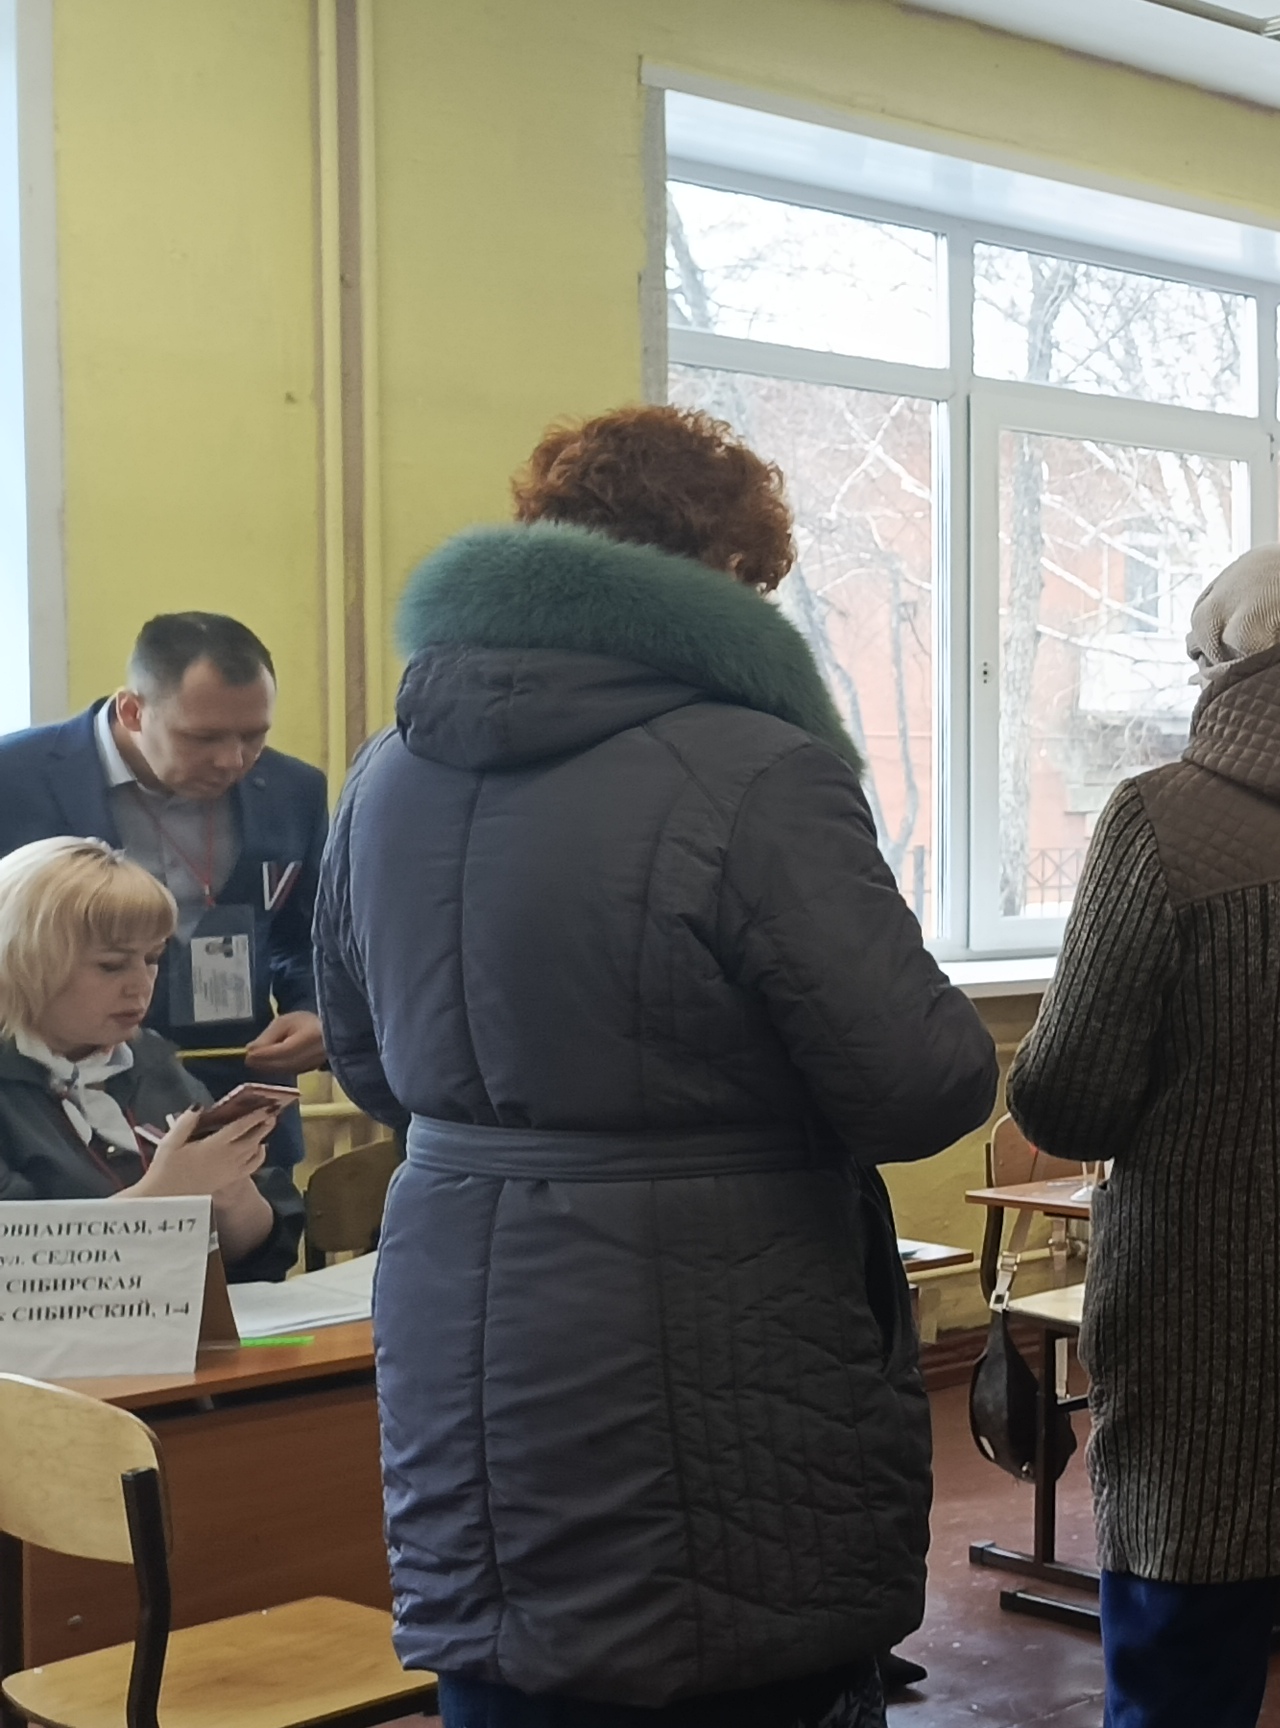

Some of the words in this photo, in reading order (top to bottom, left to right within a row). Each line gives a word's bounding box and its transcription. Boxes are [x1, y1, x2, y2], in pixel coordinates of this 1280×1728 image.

[157, 1218, 197, 1233] 4-17
[32, 1249, 121, 1266] СЕДОВА
[6, 1276, 142, 1294] СИБИРСКАЯ
[12, 1300, 156, 1321] СИБИРСКИЙ,
[164, 1302, 190, 1316] 1-4
